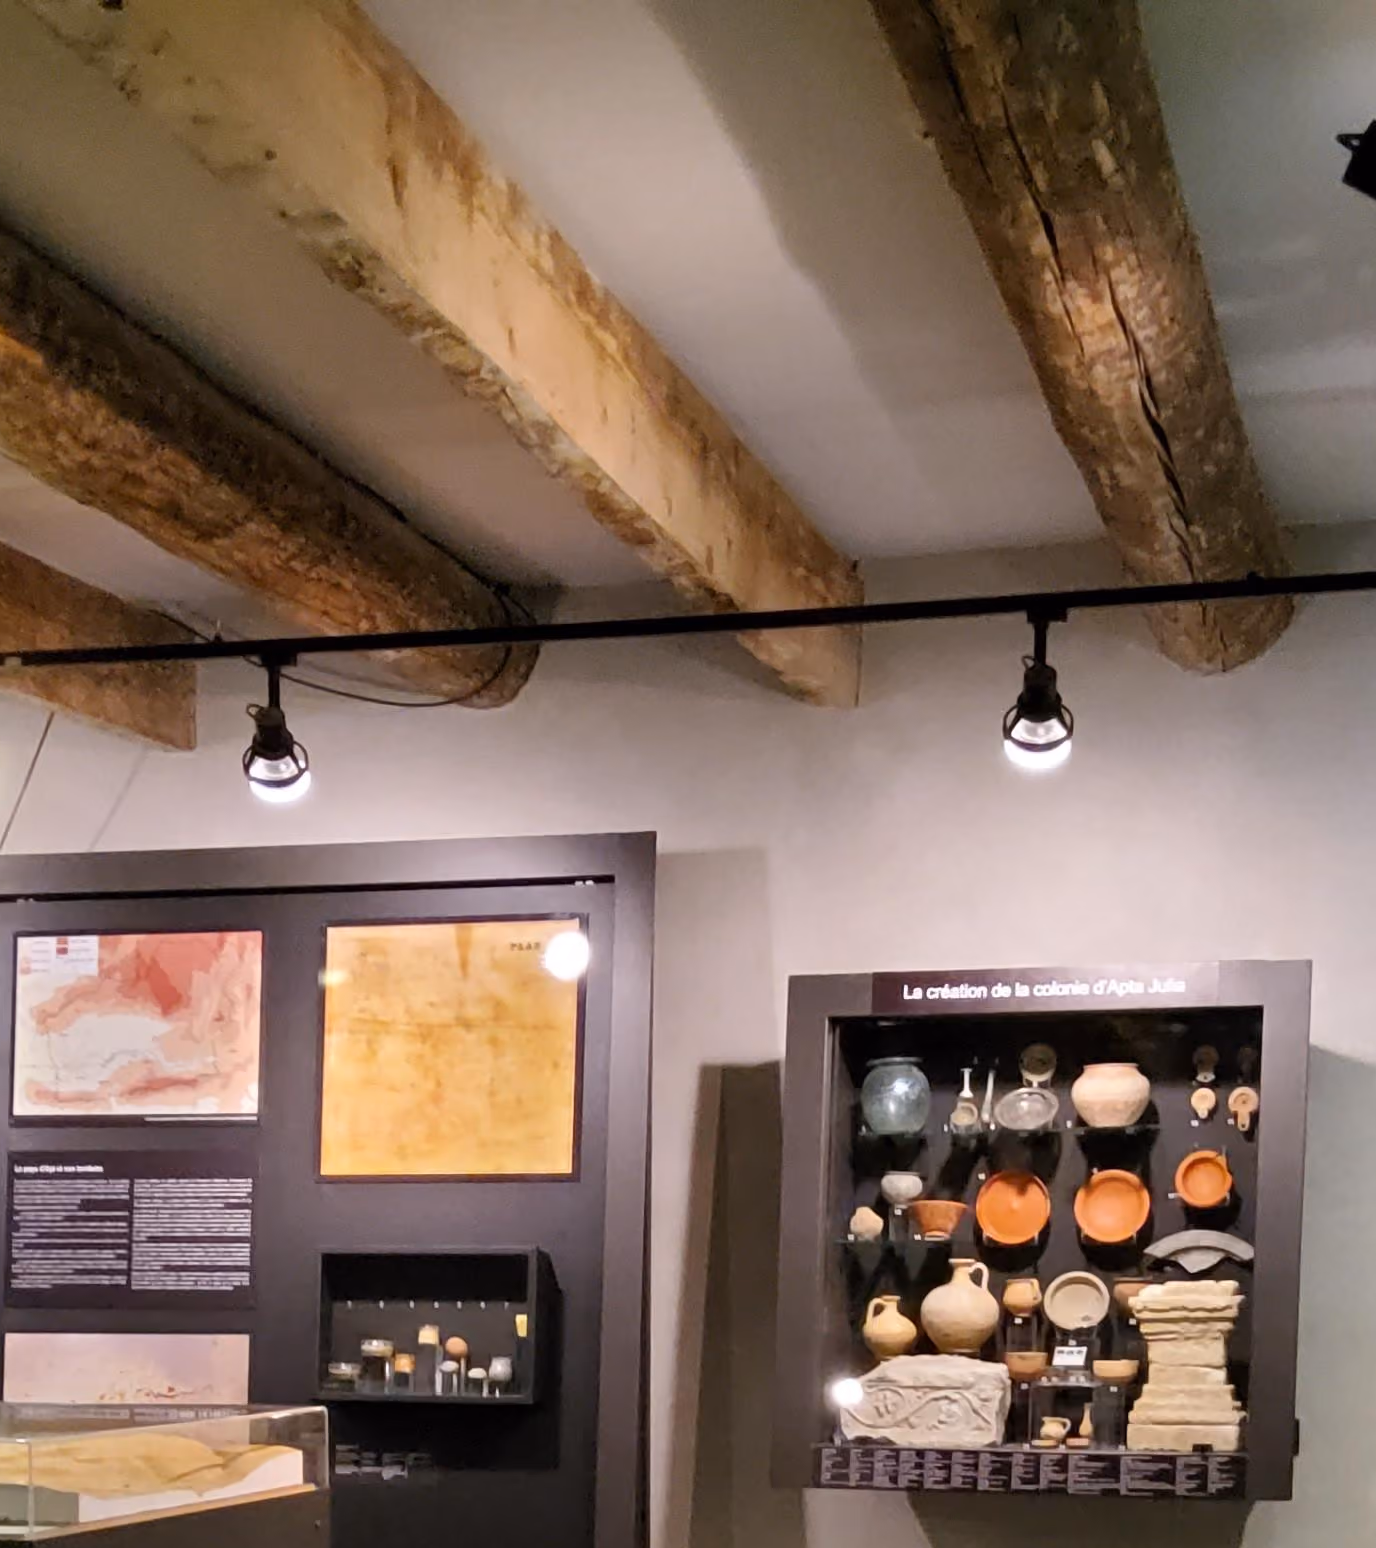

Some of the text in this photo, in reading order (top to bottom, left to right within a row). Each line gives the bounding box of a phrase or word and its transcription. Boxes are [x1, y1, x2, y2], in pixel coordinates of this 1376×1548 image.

[903, 978, 1186, 1000] La création de la colonie d'Apta Julia
